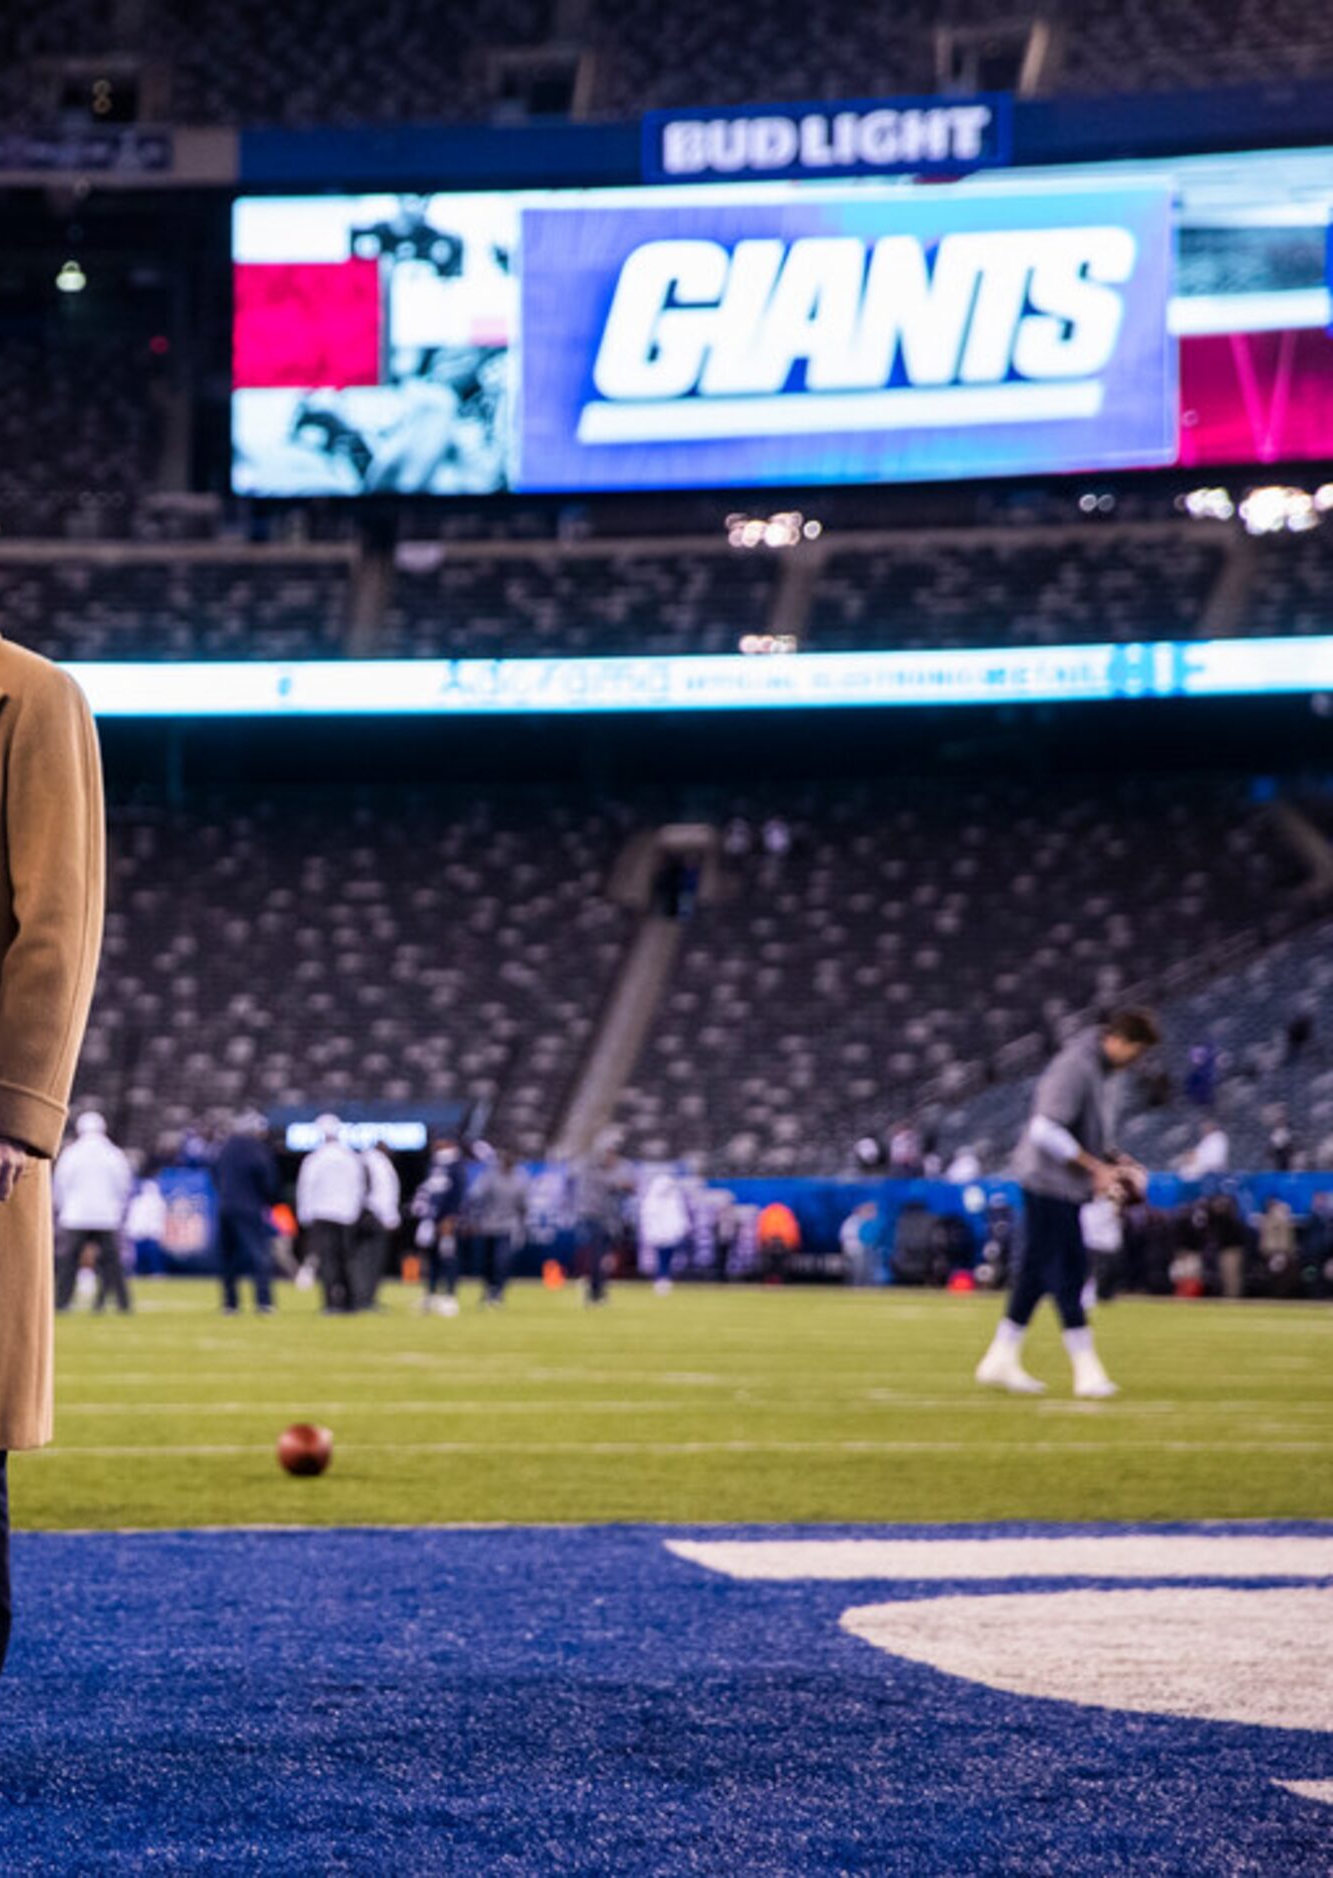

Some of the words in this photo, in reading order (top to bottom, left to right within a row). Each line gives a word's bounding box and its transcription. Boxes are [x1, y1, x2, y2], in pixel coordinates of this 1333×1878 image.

[663, 115, 798, 175] BUD
[799, 104, 992, 167] LIGHT
[592, 225, 1136, 402] GIANTS
